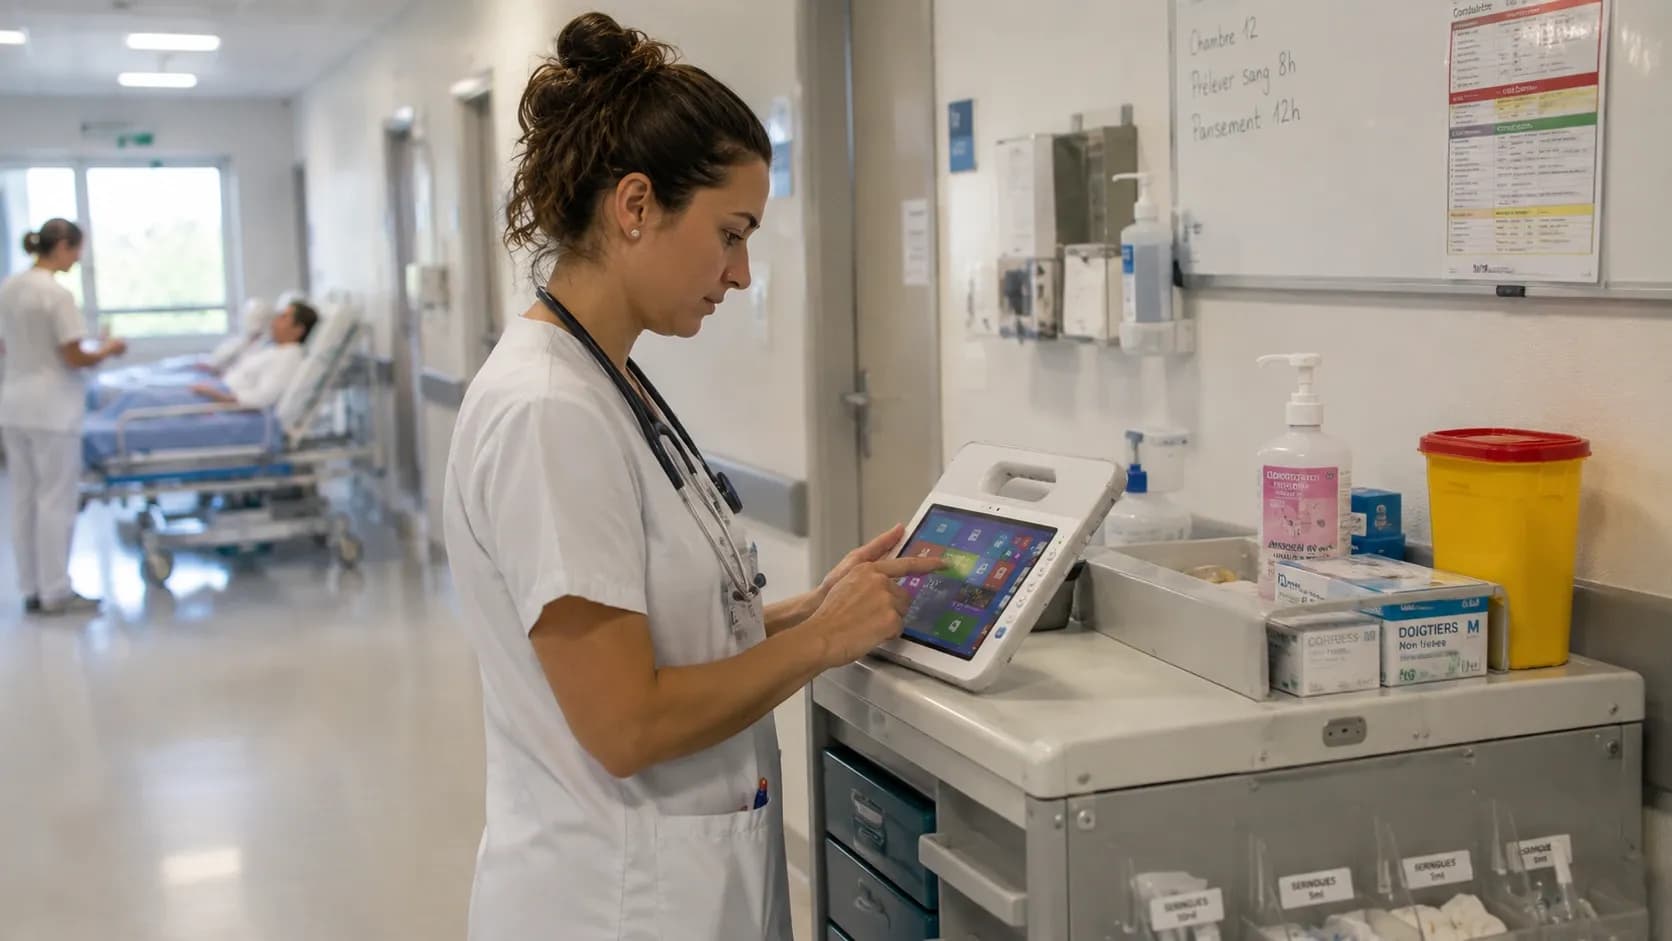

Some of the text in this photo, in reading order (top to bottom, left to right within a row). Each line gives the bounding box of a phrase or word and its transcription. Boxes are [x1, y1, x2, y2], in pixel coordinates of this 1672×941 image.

[1191, 15, 1259, 56] Chambre 12
[1242, 66, 1270, 96] sang
[1279, 50, 1296, 76] 8h
[1192, 96, 1301, 141] Pansement 12h
[1398, 619, 1480, 639] DOIGTIERS M
[1399, 640, 1418, 651] Non
